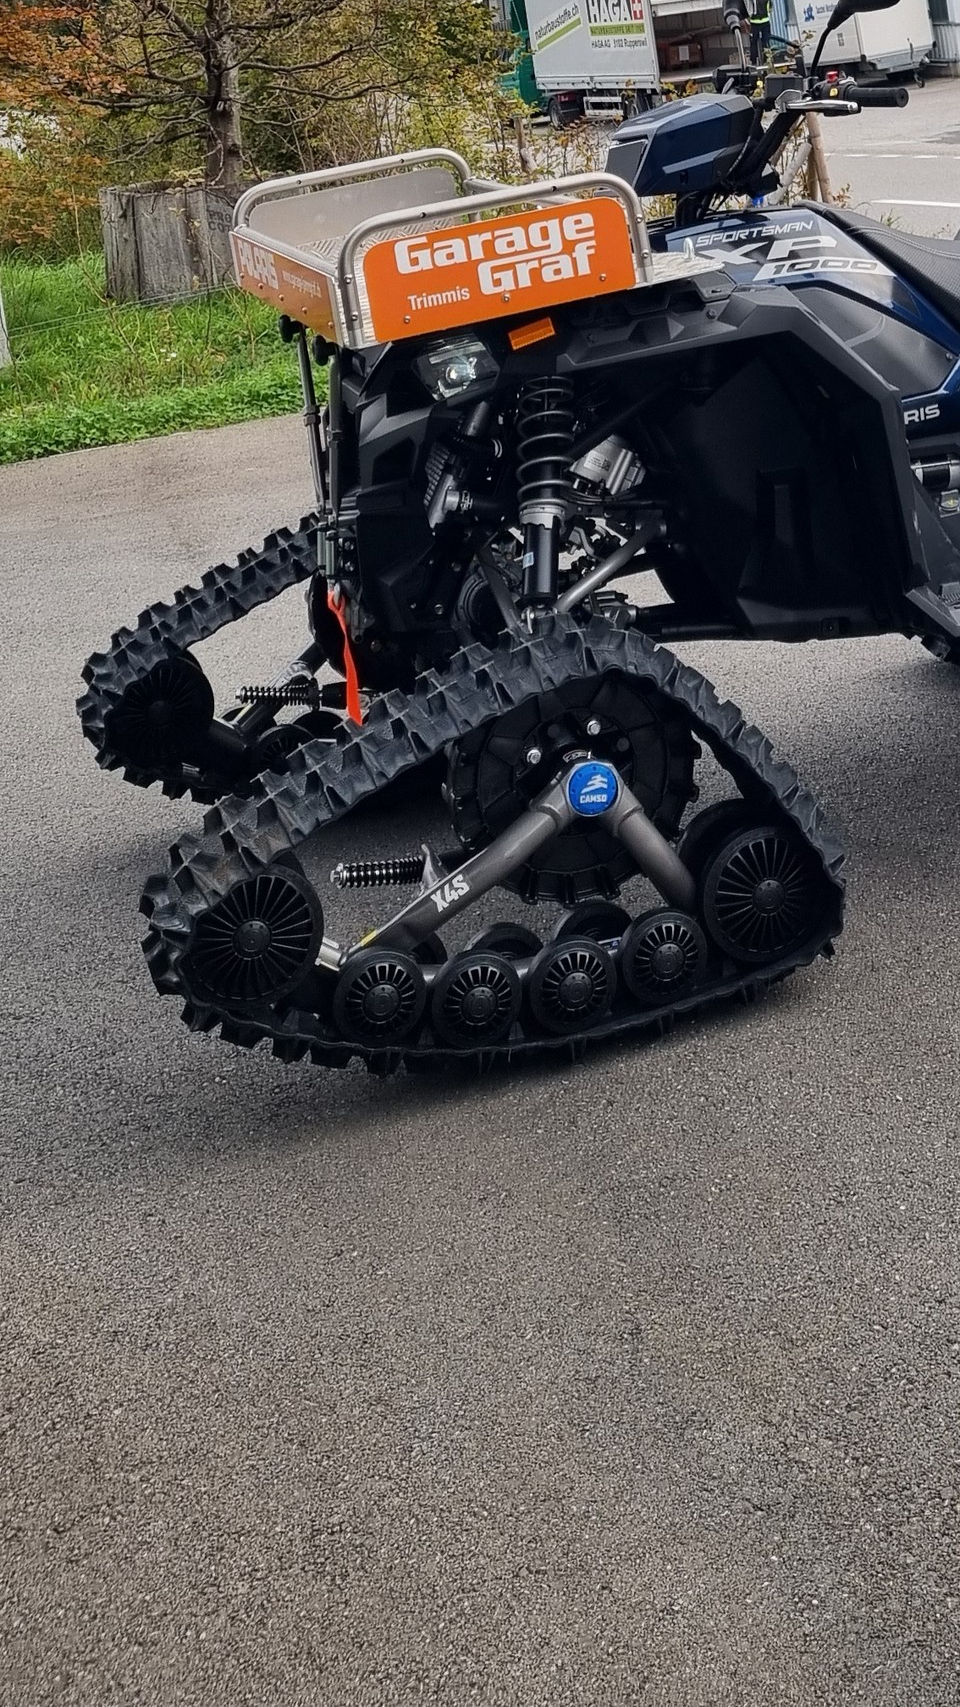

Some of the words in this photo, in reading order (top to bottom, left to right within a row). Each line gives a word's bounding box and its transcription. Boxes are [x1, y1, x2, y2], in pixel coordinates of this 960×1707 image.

[394, 212, 596, 274] Garage
[695, 220, 814, 247] SPORTSMAN
[698, 235, 838, 265] XP
[477, 240, 597, 295] Graf
[772, 259, 878, 276] 1000
[407, 286, 470, 311] Trimmis
[903, 404, 941, 425] RIS
[580, 794, 608, 804] CAMSO
[430, 874, 469, 913] X4S
